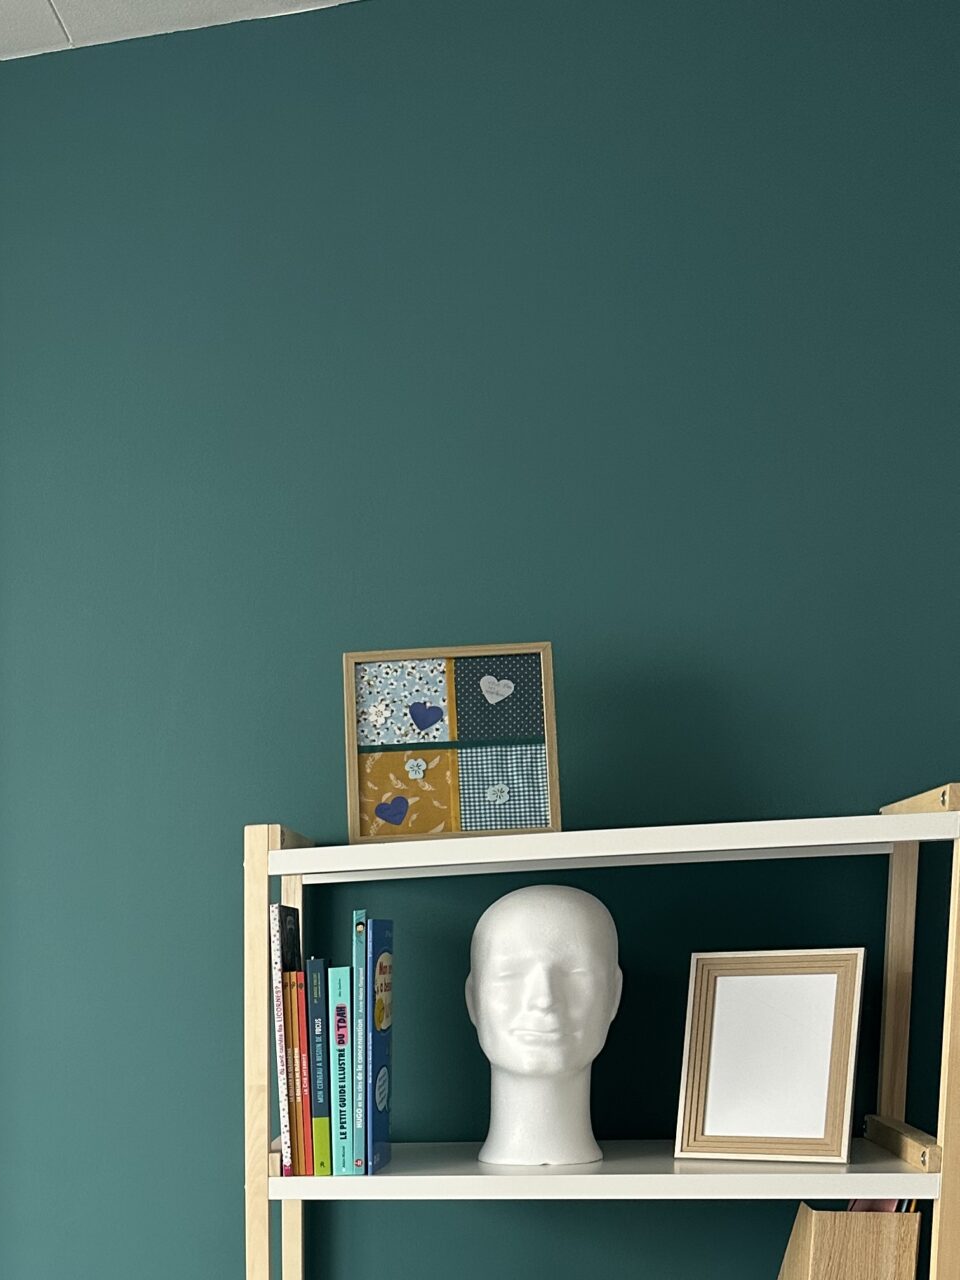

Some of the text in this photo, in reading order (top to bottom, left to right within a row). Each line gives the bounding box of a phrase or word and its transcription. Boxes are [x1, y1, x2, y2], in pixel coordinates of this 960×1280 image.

[336, 1006, 346, 1031] TDAH
[337, 1034, 345, 1045] DU
[336, 1048, 346, 1083] ILLUSTRÉ
[356, 1072, 363, 1080] de
[338, 1084, 346, 1108] GUIDE
[340, 1131, 347, 1140] LE
